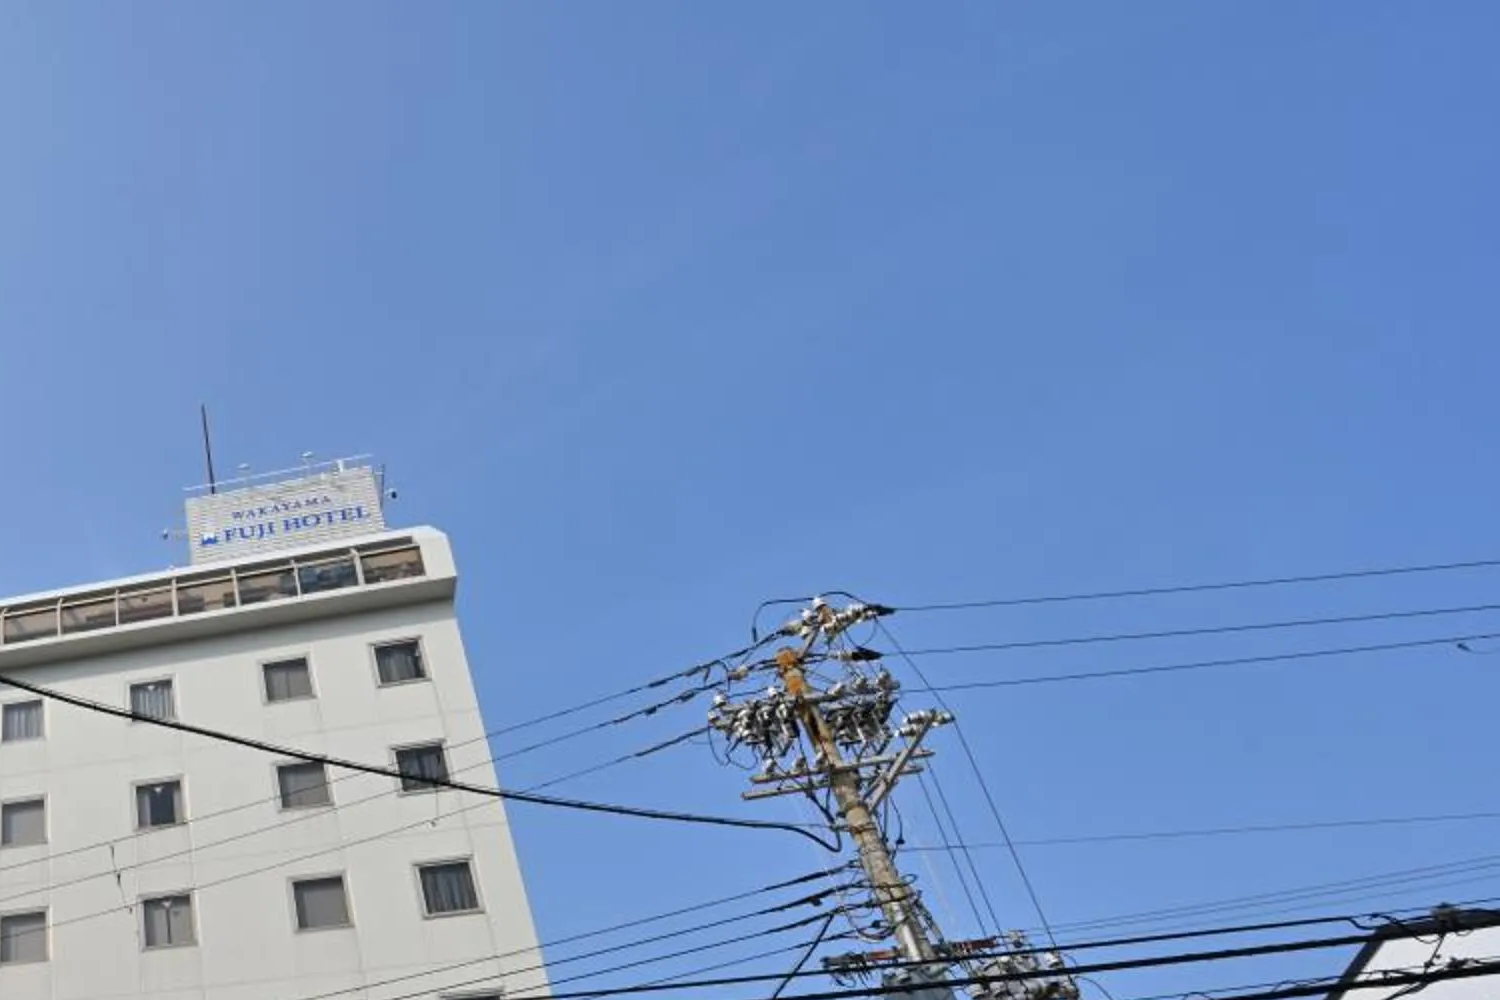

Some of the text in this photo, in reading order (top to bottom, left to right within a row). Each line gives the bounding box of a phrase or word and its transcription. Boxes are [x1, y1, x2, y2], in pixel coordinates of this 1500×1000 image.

[231, 495, 332, 520] WAKAYAMA
[224, 505, 372, 543] FUJI HOTEL
